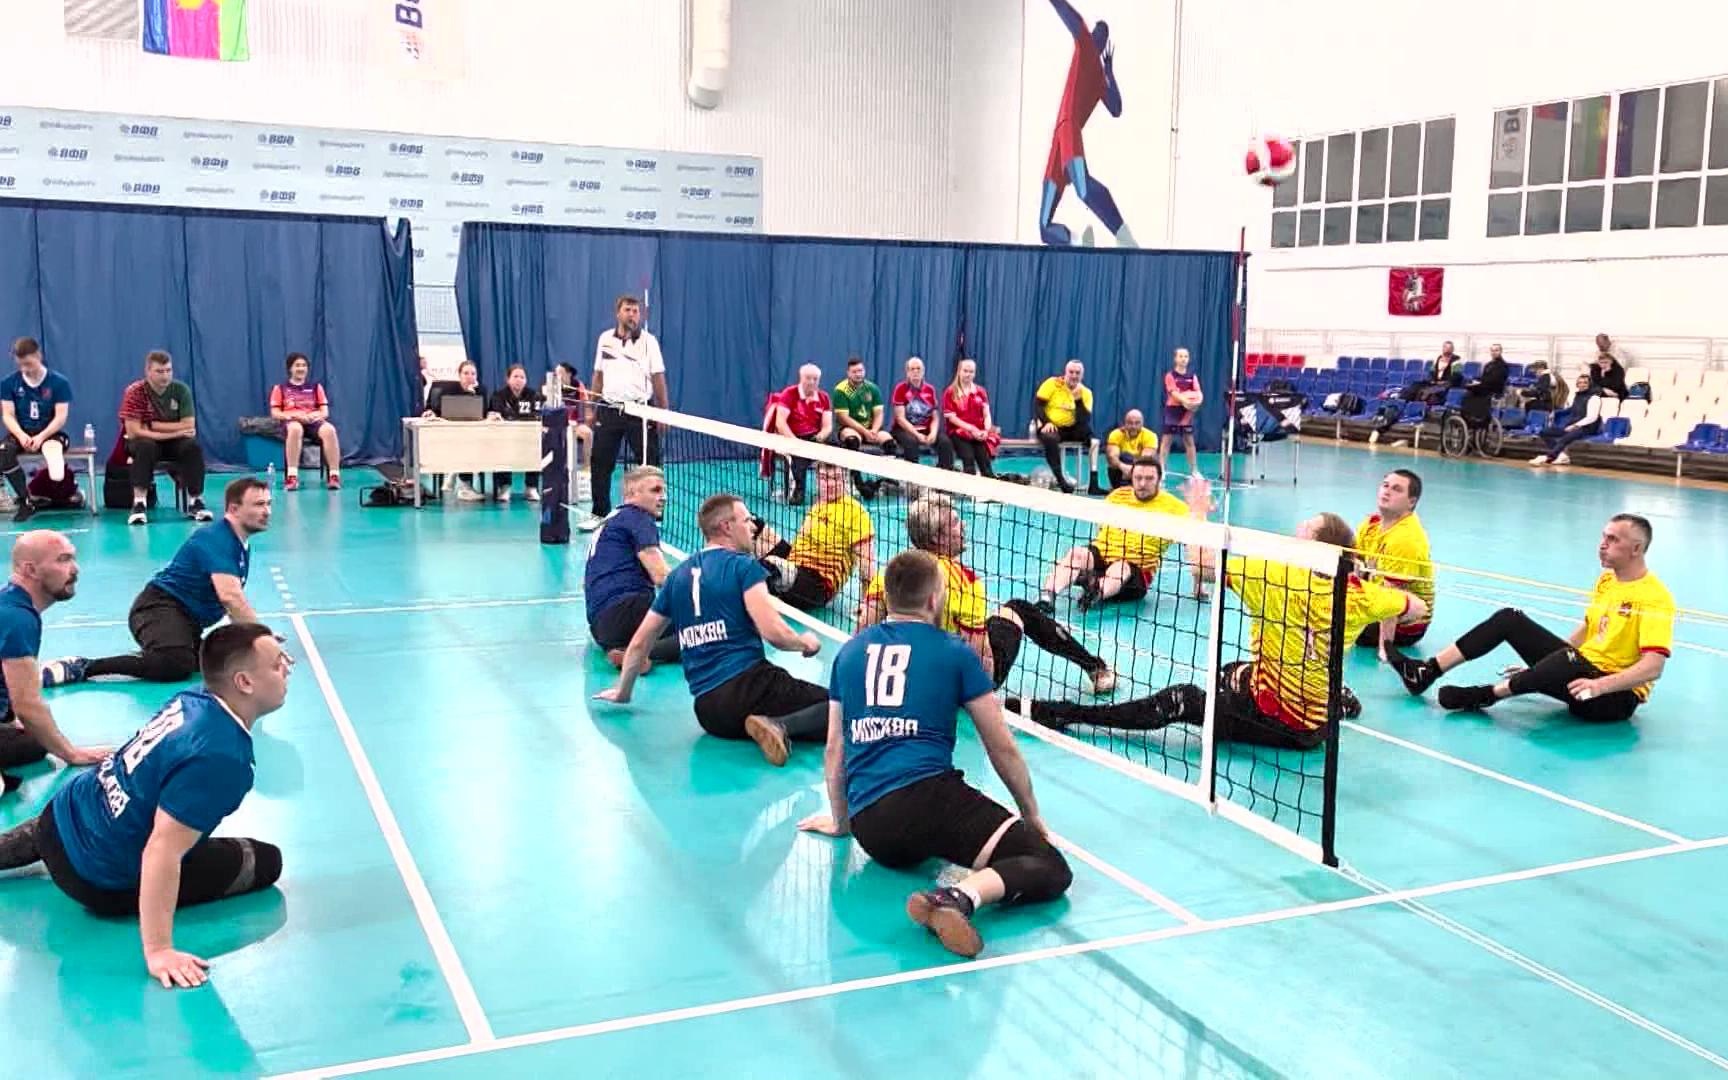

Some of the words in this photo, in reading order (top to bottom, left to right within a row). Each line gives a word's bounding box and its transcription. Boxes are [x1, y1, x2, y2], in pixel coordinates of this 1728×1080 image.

[519, 401, 530, 413] 22
[691, 567, 701, 617] 1
[679, 620, 727, 650] МОСКВА
[865, 643, 912, 706] 18
[851, 716, 918, 744] МОСКВА
